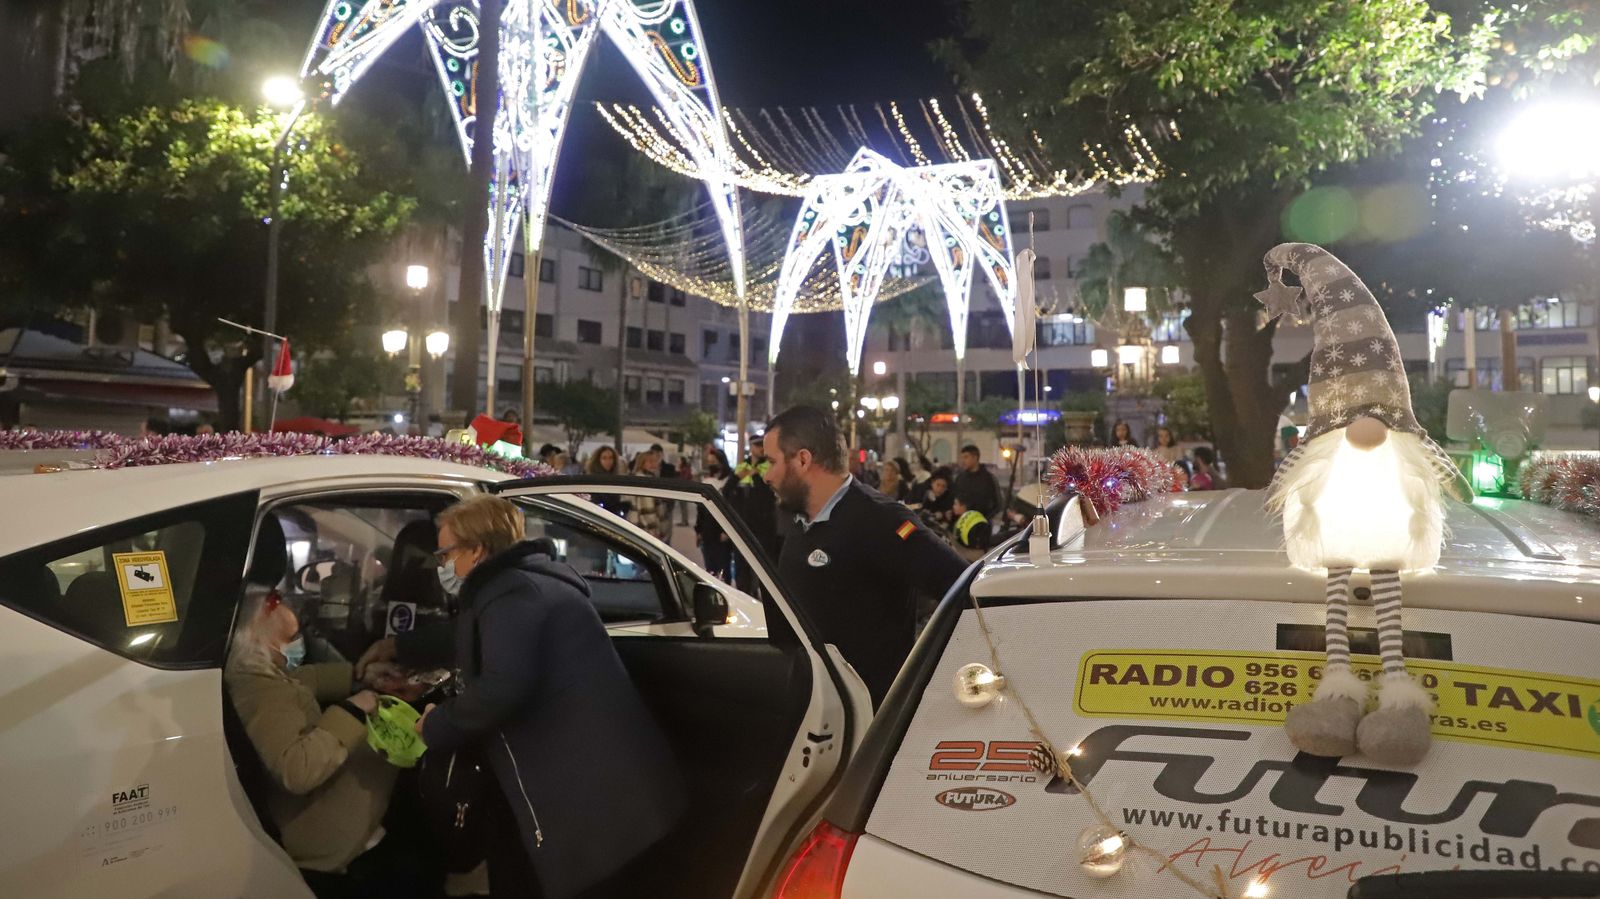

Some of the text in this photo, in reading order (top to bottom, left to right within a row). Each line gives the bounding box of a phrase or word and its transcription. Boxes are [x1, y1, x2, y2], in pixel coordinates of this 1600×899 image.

[1089, 663, 1235, 689] RADIO
[1245, 662, 1299, 679] 956
[1244, 680, 1298, 697] 626
[1453, 681, 1583, 719] TAXI
[929, 741, 1042, 772] 25
[112, 786, 149, 804] FAAT
[945, 791, 1007, 805] FUTURA
[104, 817, 127, 832] 900
[132, 811, 153, 826] 200
